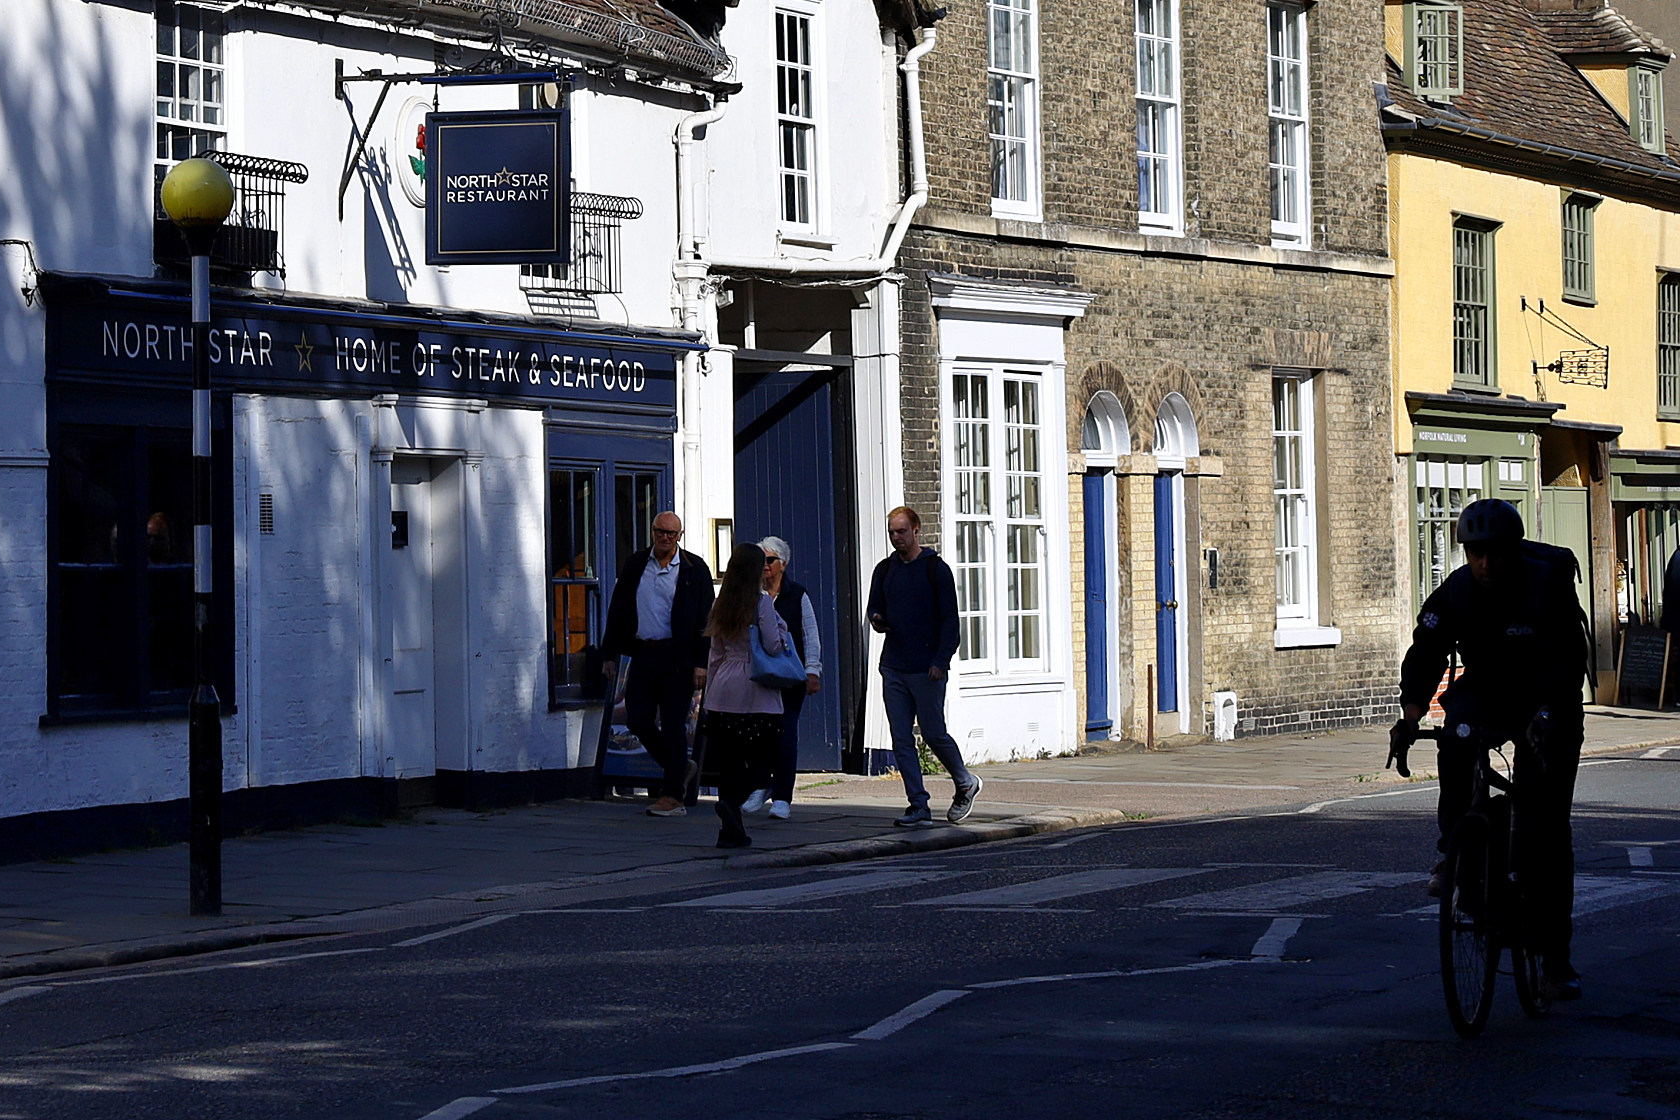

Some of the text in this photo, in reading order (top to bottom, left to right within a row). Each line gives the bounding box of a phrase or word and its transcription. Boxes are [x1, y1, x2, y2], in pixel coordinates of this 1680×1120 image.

[446, 173, 549, 189] NORTH STAR
[446, 189, 549, 203] RESTAURANT
[103, 320, 645, 393] NORTH STAR HOME OF STEAK & SEAFOOD
